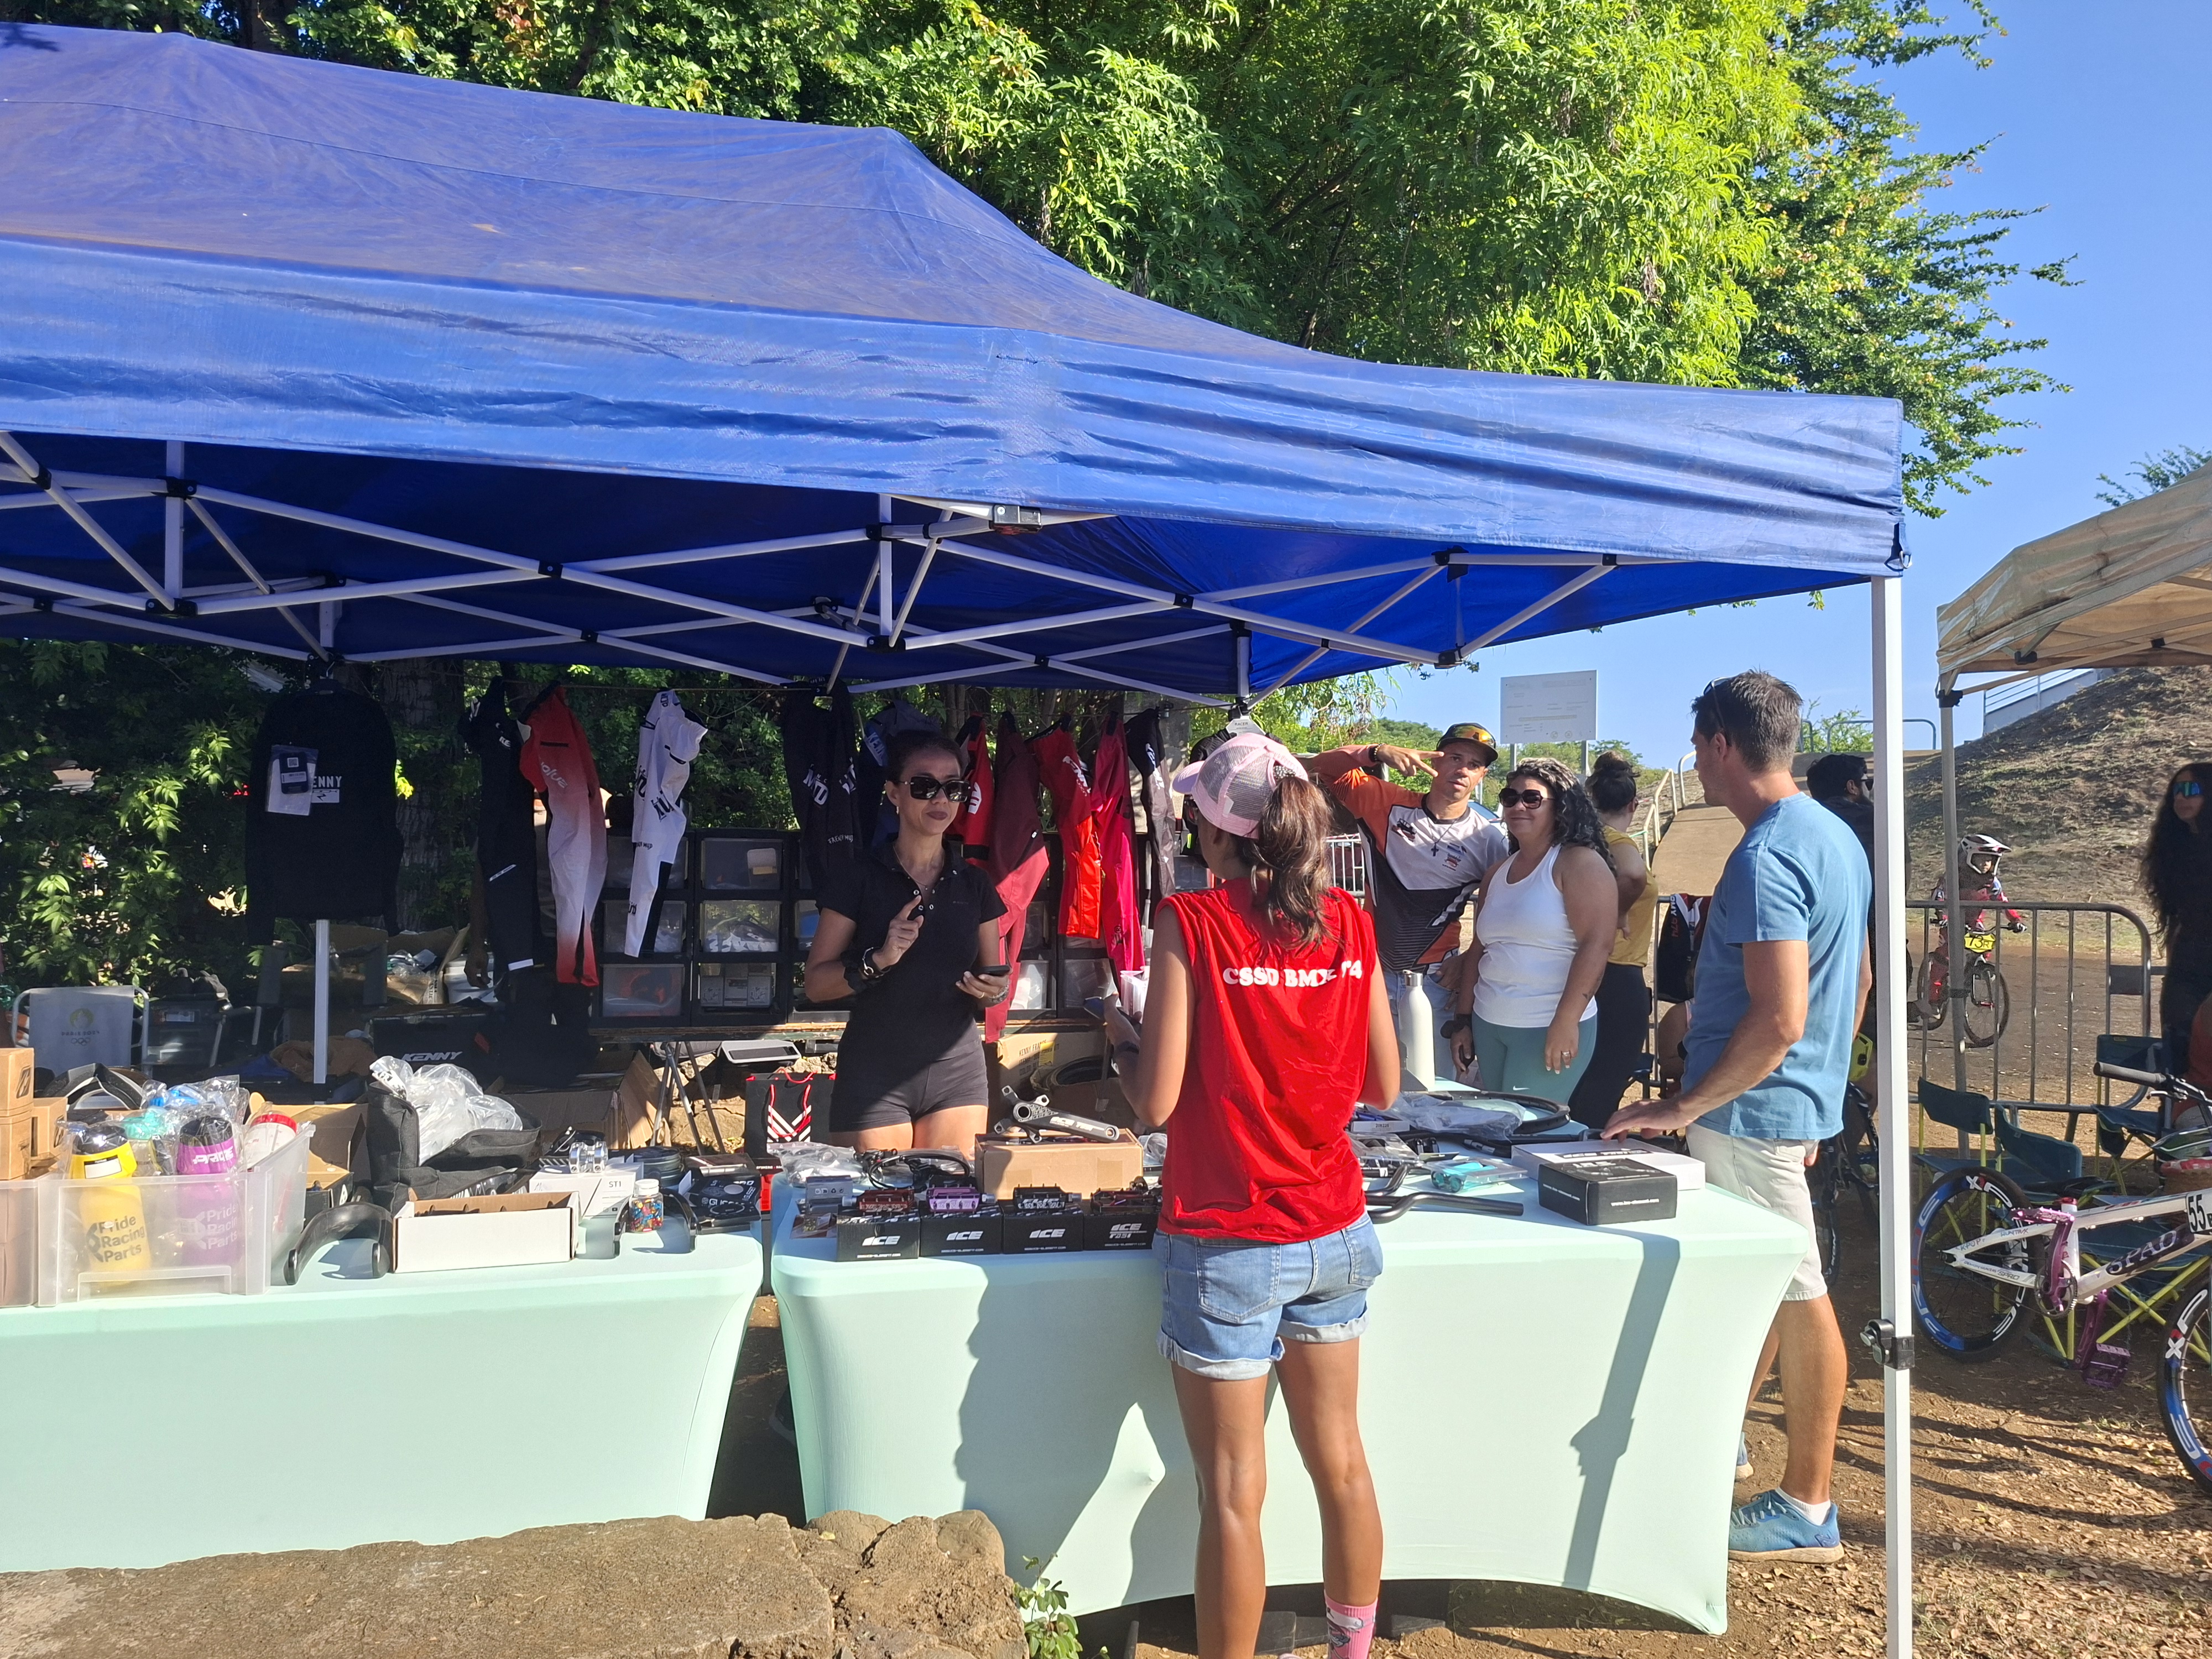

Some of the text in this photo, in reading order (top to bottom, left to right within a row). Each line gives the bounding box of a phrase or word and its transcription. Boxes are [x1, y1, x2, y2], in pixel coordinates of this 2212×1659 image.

[313, 776, 342, 788] ENNY
[1223, 967, 1279, 987] CSSD
[401, 1051, 463, 1062] KENNY
[98, 1215, 136, 1234] Pide
[101, 1225, 145, 1248] Racing
[946, 1231, 983, 1241] ICE
[1029, 1229, 1066, 1238] ICE
[862, 1235, 900, 1246] ICE
[104, 1244, 142, 1262] Parts
[2109, 1230, 2177, 1274] SPAD
[1997, 1271, 2020, 1280] SPAD
